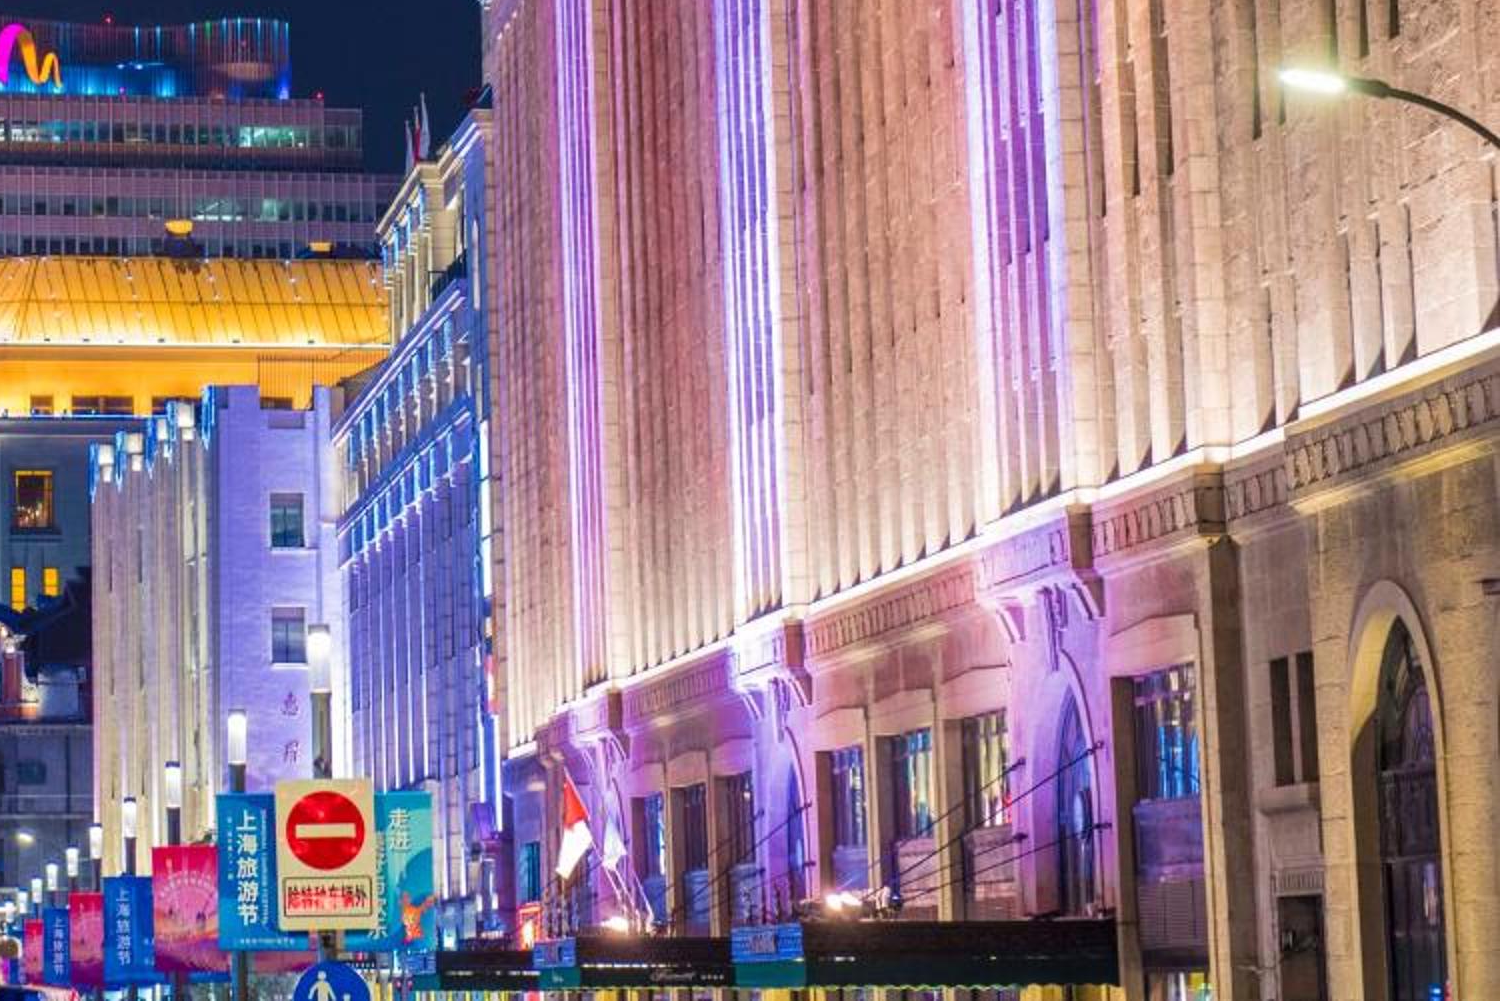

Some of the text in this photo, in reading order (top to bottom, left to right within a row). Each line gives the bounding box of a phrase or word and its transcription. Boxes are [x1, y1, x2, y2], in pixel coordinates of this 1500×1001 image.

[236, 809, 259, 925] 上海旅游节
[389, 808, 412, 852] 走进
[116, 889, 132, 966] 上海旅游节
